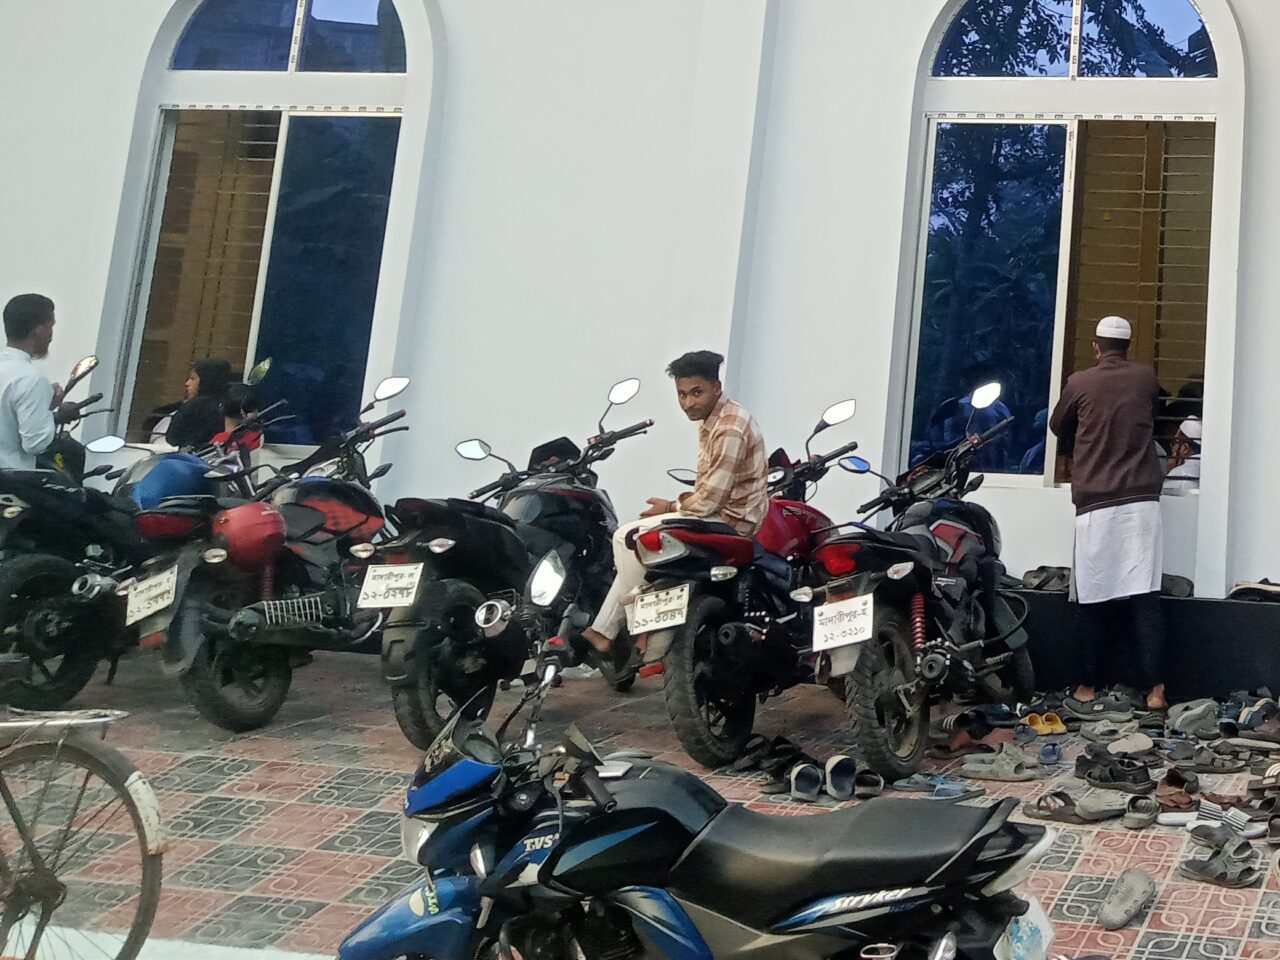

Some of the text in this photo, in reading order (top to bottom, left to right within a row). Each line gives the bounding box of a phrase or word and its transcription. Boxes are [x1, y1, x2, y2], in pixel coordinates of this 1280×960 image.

[823, 626, 866, 643] ১২-৩২১০
[523, 834, 554, 852] TVS
[833, 887, 913, 910] Stryker
